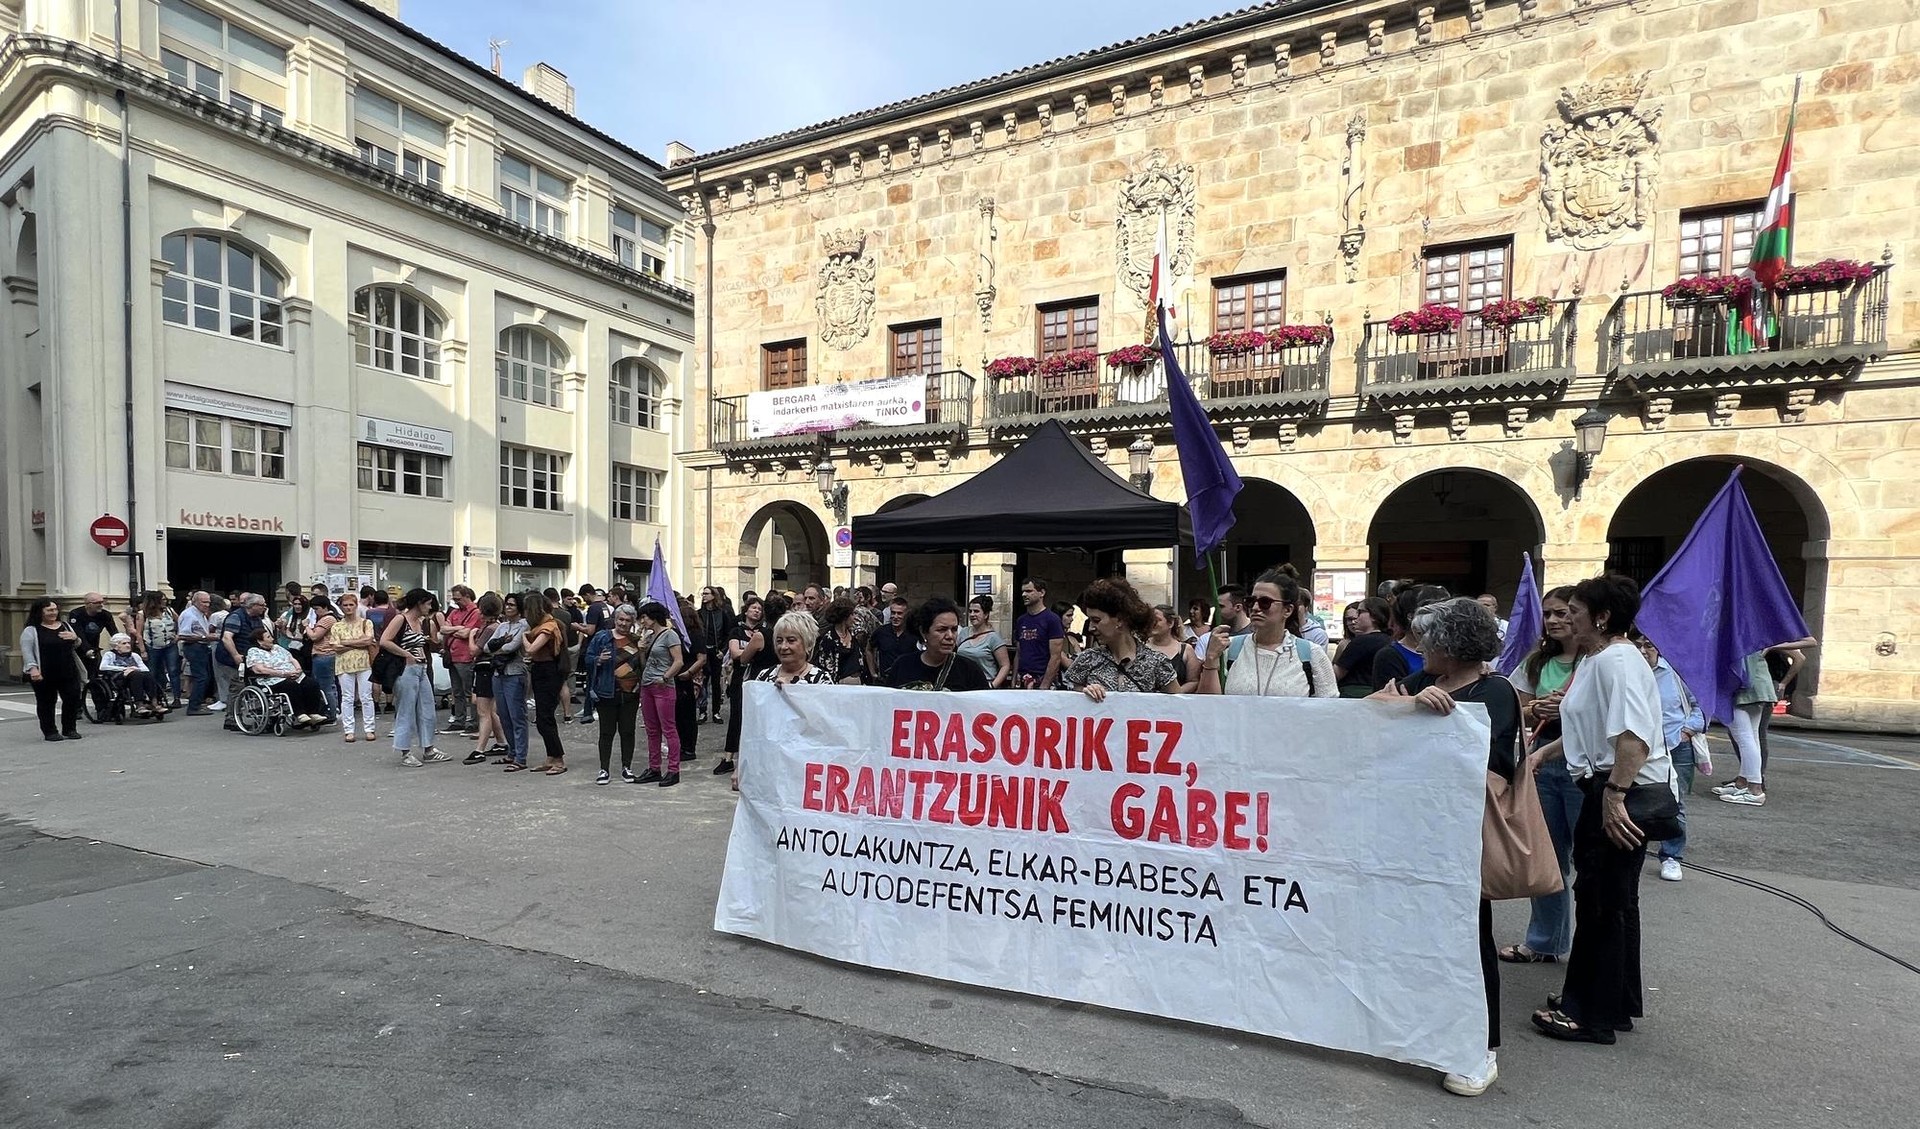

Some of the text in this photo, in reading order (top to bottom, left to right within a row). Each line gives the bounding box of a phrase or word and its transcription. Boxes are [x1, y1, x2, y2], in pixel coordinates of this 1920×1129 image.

[772, 393, 817, 406] BERGARA
[773, 396, 907, 416] indarkeria matxistaren aurka,
[386, 438, 414, 447] ABOGADOS
[419, 443, 444, 452] ASESORES
[395, 426, 436, 441] Hidalgo
[180, 508, 284, 532] kutxabank
[891, 709, 1198, 787] ERASORIK EZ,
[802, 762, 1269, 852] ERANTZUNIK GABE!
[776, 826, 1309, 914] ANTOLAKUNTZA, ELKAR-BABESA ETA
[821, 868, 1218, 948] AUTODEFENTSA FEMINISTA
